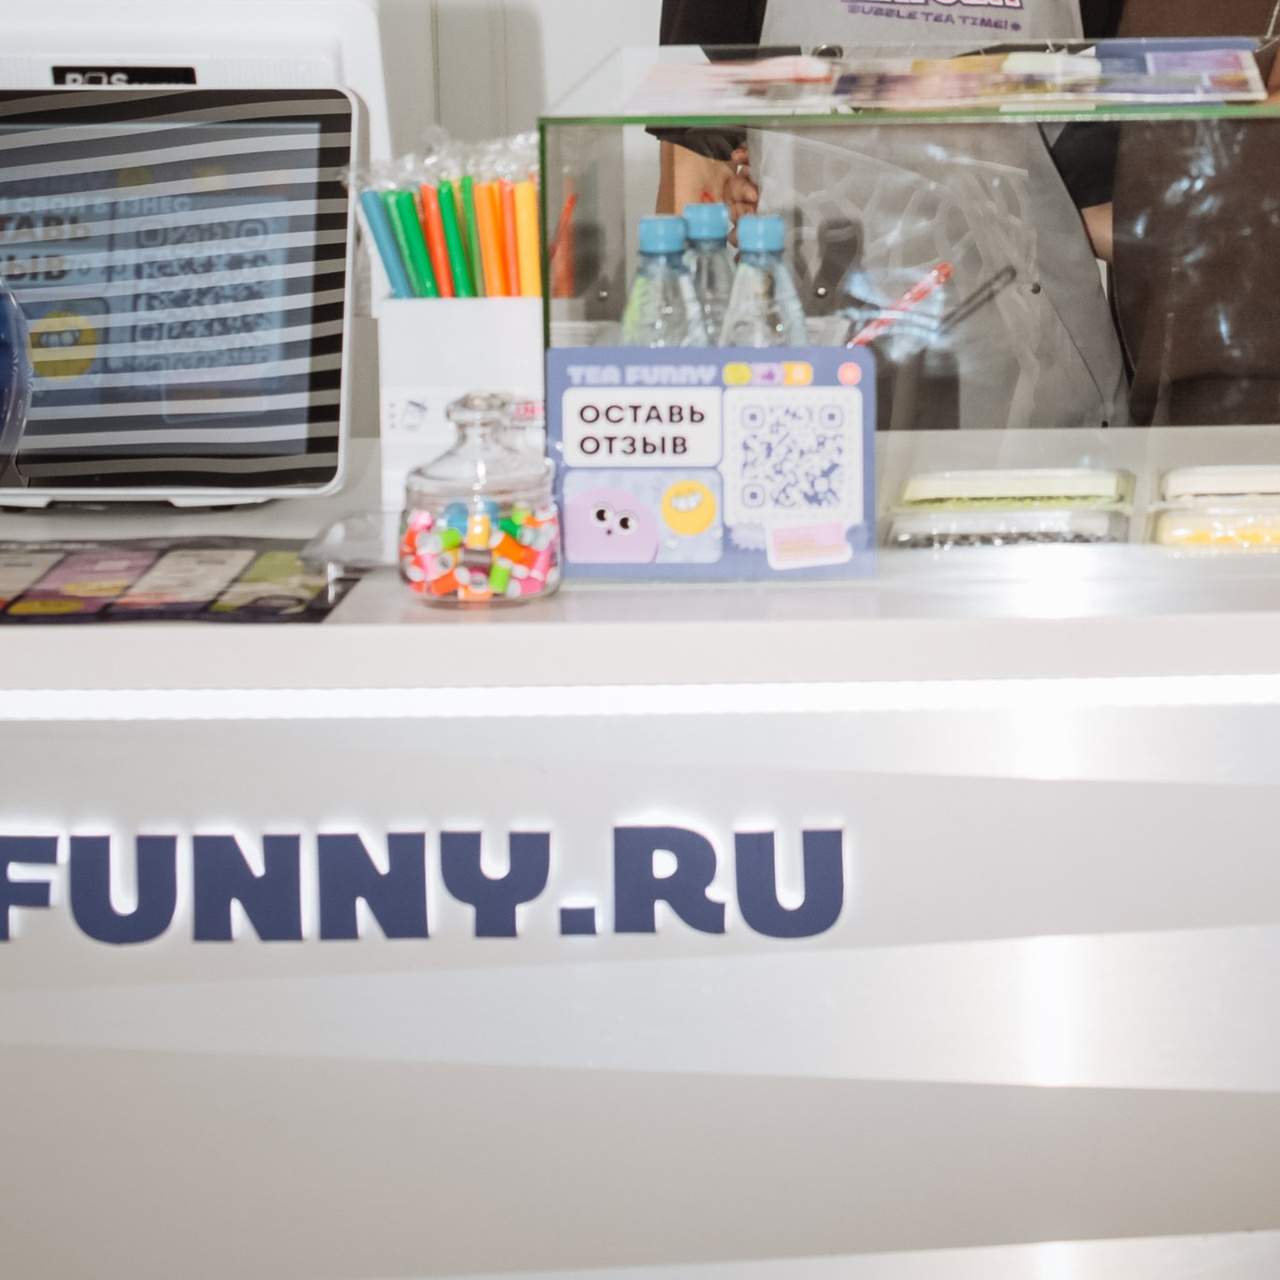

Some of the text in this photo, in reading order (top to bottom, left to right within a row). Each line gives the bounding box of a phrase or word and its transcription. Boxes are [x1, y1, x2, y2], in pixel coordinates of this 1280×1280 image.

[849, 4, 918, 20] BUBBLE
[921, 11, 955, 25] TEA
[567, 364, 717, 385] TEA FUNNY
[580, 405, 705, 424] ОСТАВЬ
[580, 436, 688, 455] ОТЗЫВ
